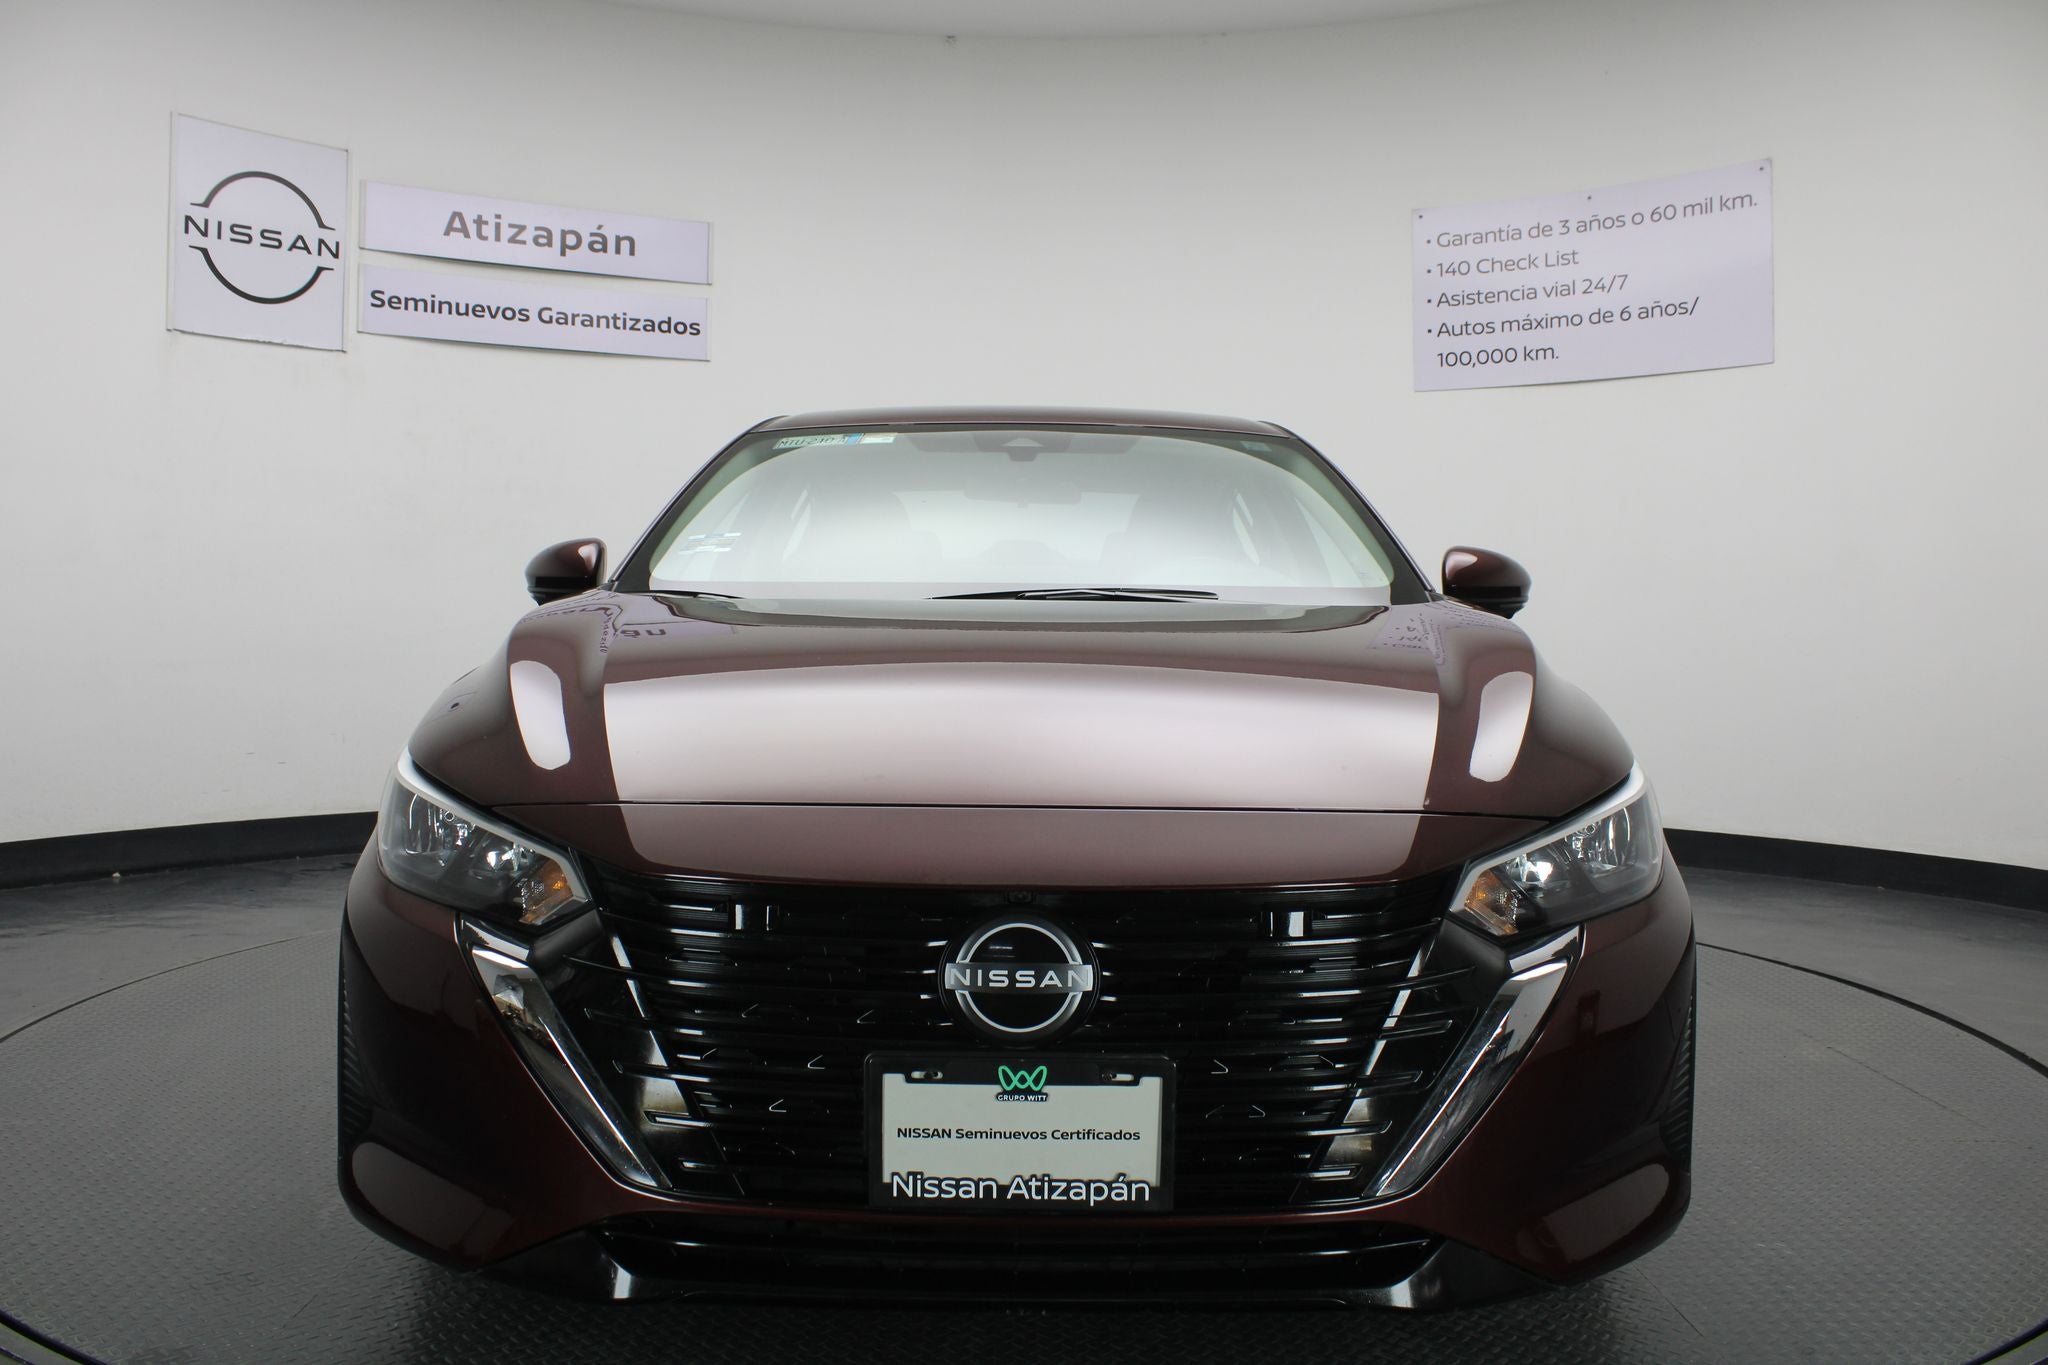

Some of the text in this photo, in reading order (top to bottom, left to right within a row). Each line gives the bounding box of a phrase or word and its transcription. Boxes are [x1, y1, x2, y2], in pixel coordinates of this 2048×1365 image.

[183, 214, 340, 260] NISSAN
[443, 210, 637, 257] Atizapán
[1436, 193, 1757, 248] Garantía de 3 años o 60 mil km.
[1436, 249, 1579, 277] 140 Check List
[1436, 274, 1628, 308] Asistencia vial 24/7
[369, 288, 701, 336] Seminuevos Garantizados
[1436, 296, 1699, 337] Autos máximo de 6 años/
[1437, 346, 1559, 368] 100,000 km.
[950, 967, 1092, 989] NISSAN
[896, 1127, 1141, 1141] NISSAN Seminuevos Certificados
[892, 1174, 1150, 1206] Nissan Atizapán
